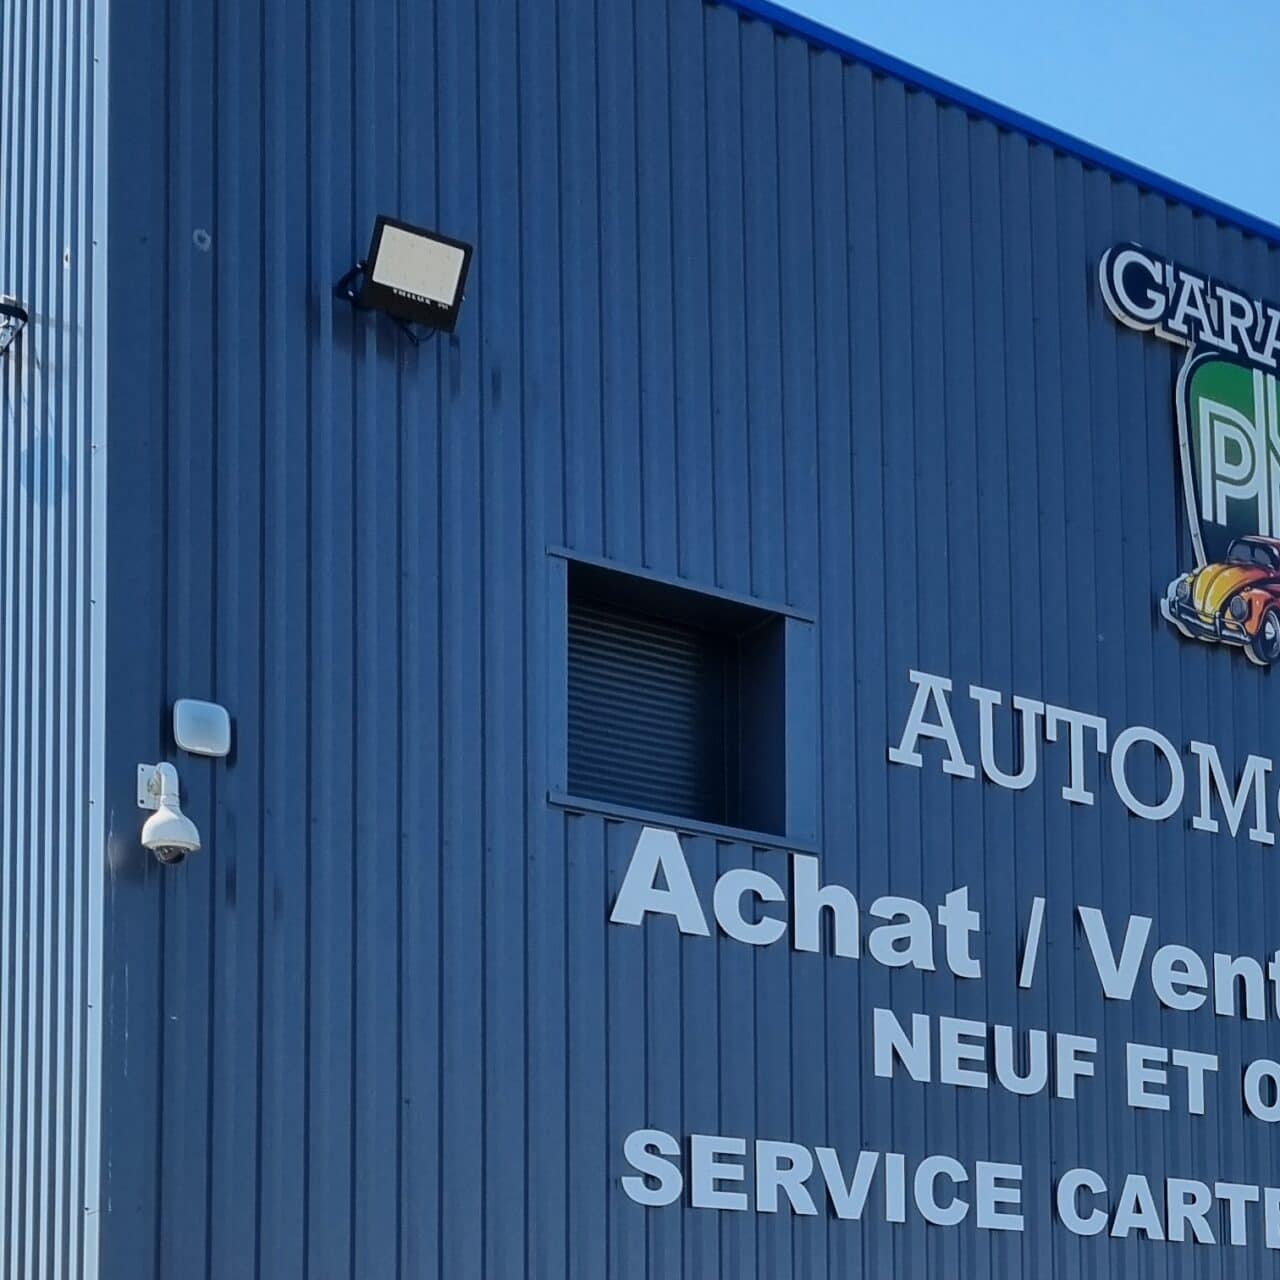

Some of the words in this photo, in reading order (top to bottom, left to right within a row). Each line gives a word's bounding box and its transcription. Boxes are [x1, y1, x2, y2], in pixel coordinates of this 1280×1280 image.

[610, 825, 982, 979] Achat
[1019, 896, 1045, 989] /
[873, 1007, 1097, 1099] NEUF
[1126, 1042, 1218, 1116] ET
[621, 1129, 1025, 1232] SERVICE
